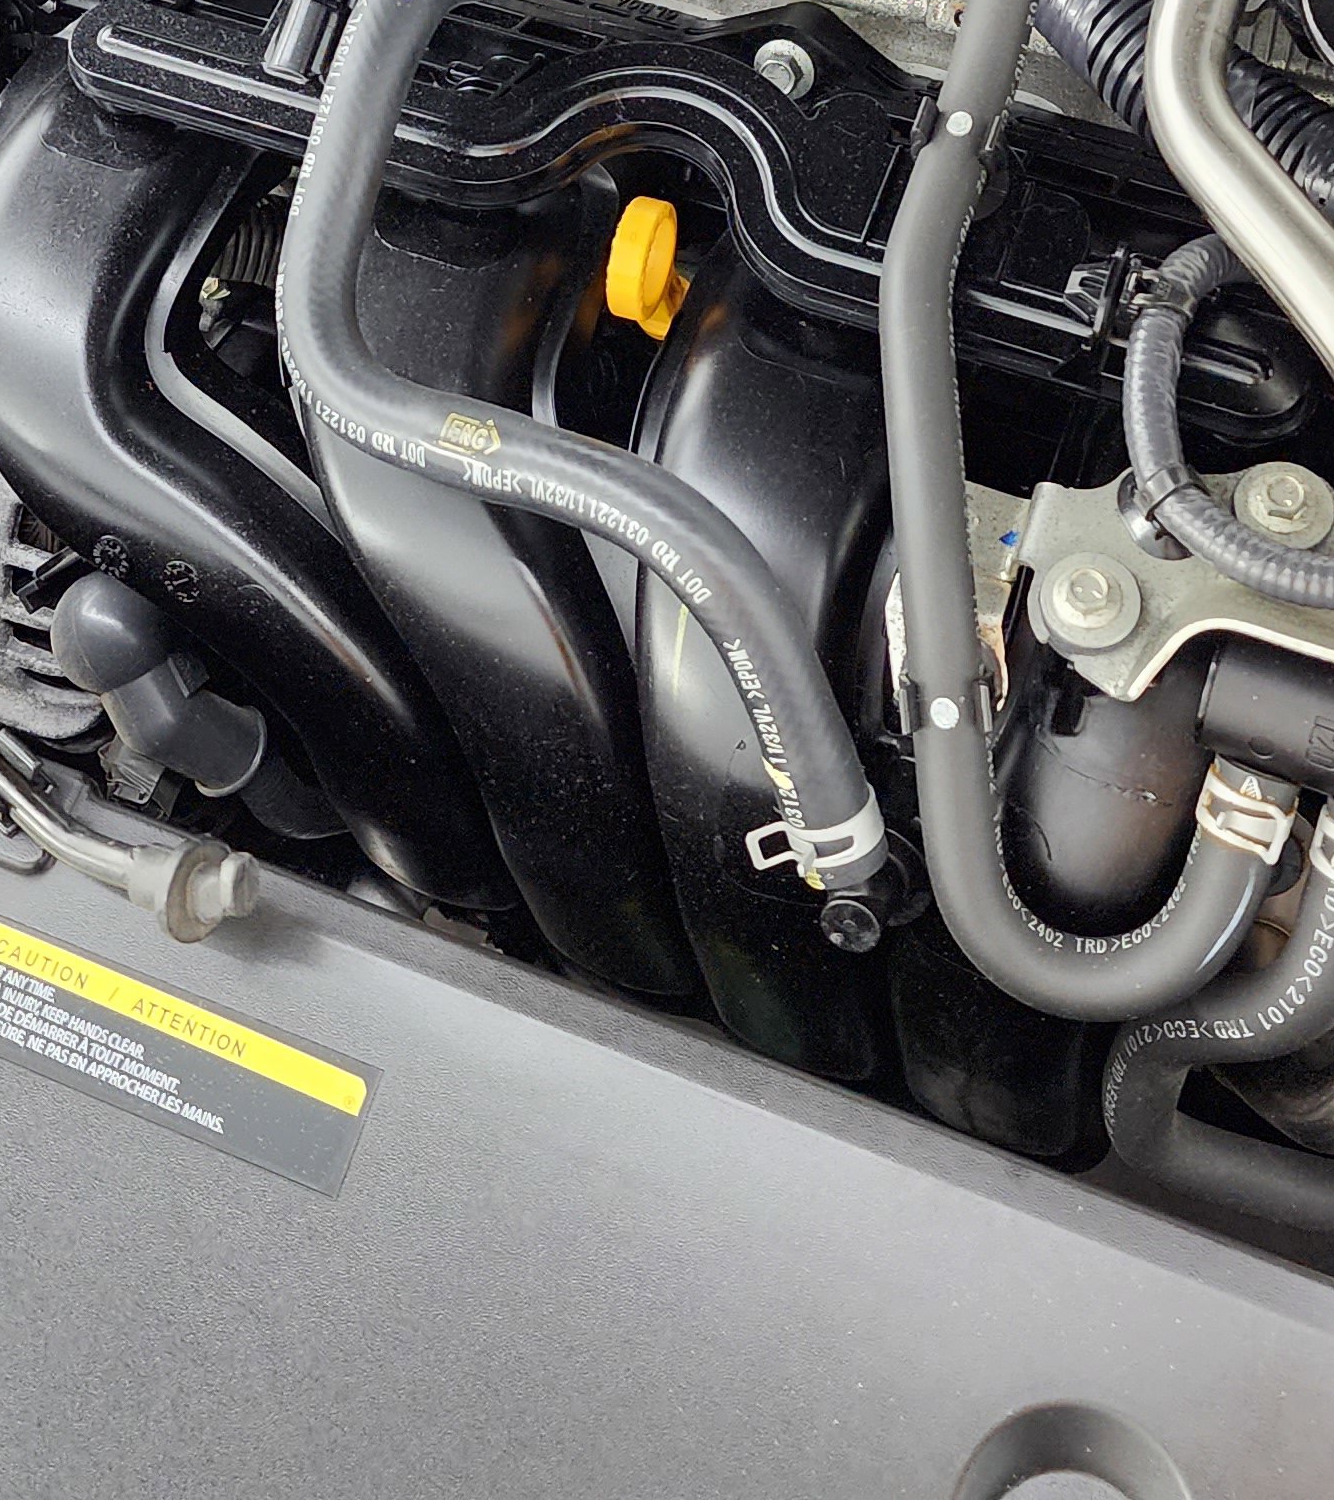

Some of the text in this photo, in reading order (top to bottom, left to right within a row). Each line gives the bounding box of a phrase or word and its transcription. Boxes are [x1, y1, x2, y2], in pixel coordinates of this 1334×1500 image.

[584, 497, 651, 548] 031221
[673, 566, 712, 606] DOT
[774, 767, 805, 830] 0312
[39, 1002, 70, 1026] KEEP
[67, 1015, 110, 1044] HANDS
[131, 998, 247, 1058] ATTENTION
[25, 1034, 47, 1054] NE
[43, 1042, 71, 1065] PAS
[66, 1053, 89, 1072] EN
[84, 1060, 162, 1104] APPROCHER
[157, 1092, 184, 1114] LES
[87, 1042, 124, 1068] TOUT
